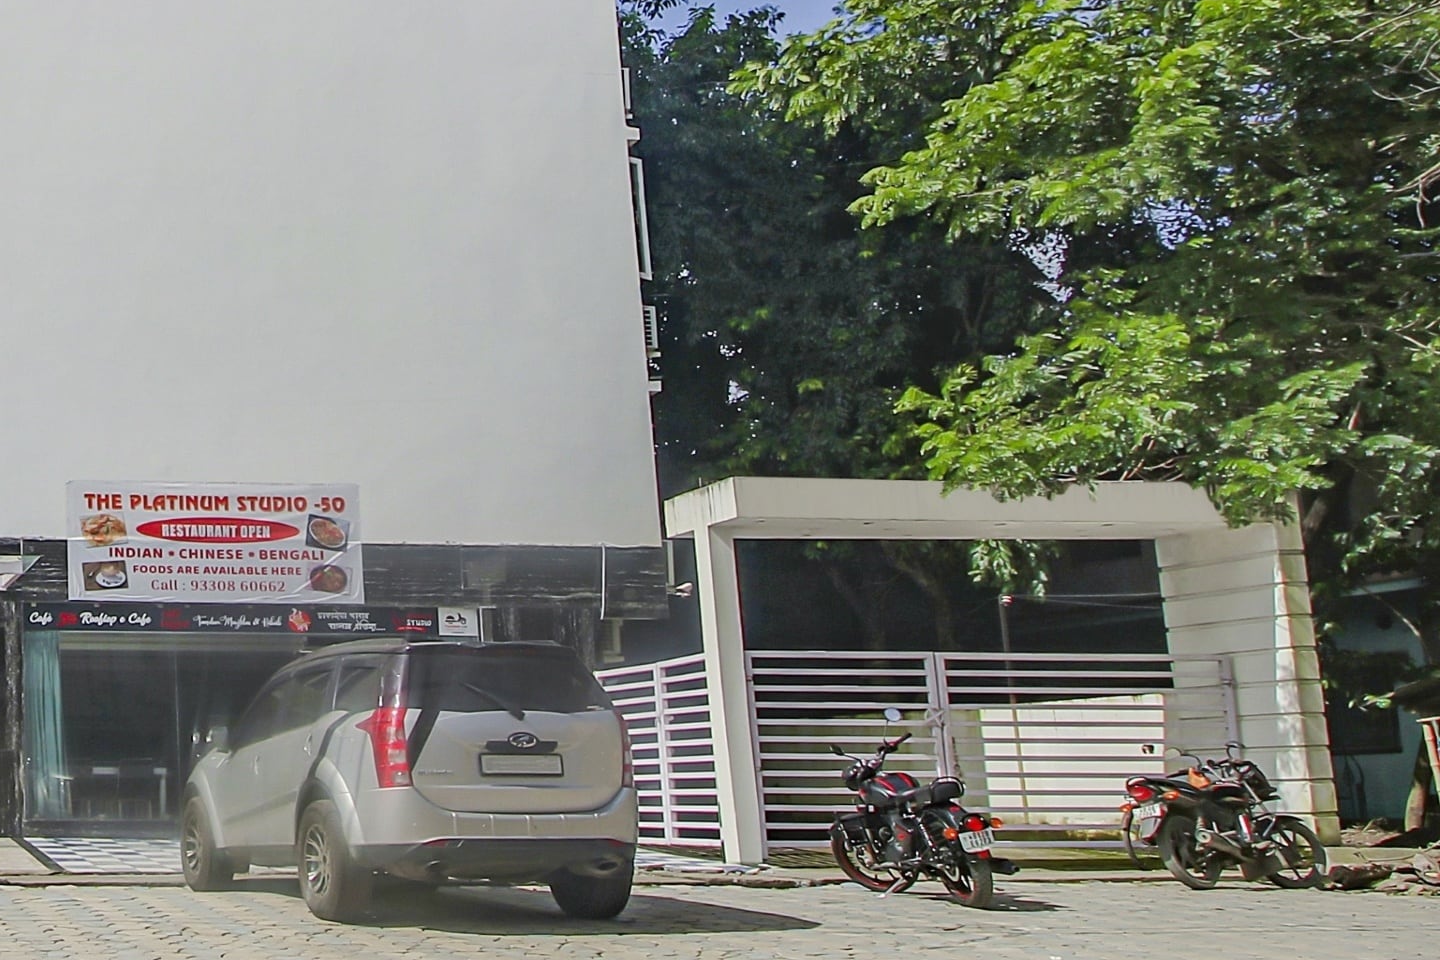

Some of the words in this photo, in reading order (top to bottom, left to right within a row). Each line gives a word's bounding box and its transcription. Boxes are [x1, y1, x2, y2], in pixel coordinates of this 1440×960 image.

[84, 493, 123, 510] THE
[129, 494, 229, 513] PLATINUM
[237, 496, 308, 513] STUDIO
[314, 497, 346, 513] -50
[161, 524, 237, 539] RESTAURANT
[240, 524, 271, 539] OPEN
[108, 547, 163, 559] INDIAN
[178, 548, 244, 560] CHINESE
[259, 549, 325, 561] BENGALI
[133, 565, 174, 575] FOODS
[177, 565, 200, 575] ARE
[203, 565, 268, 576] AVAILABLE
[271, 566, 303, 576] HERE
[150, 580, 179, 591] Call
[190, 580, 236, 592] 93308
[240, 581, 287, 593] 60662
[79, 611, 118, 627] Rooftop
